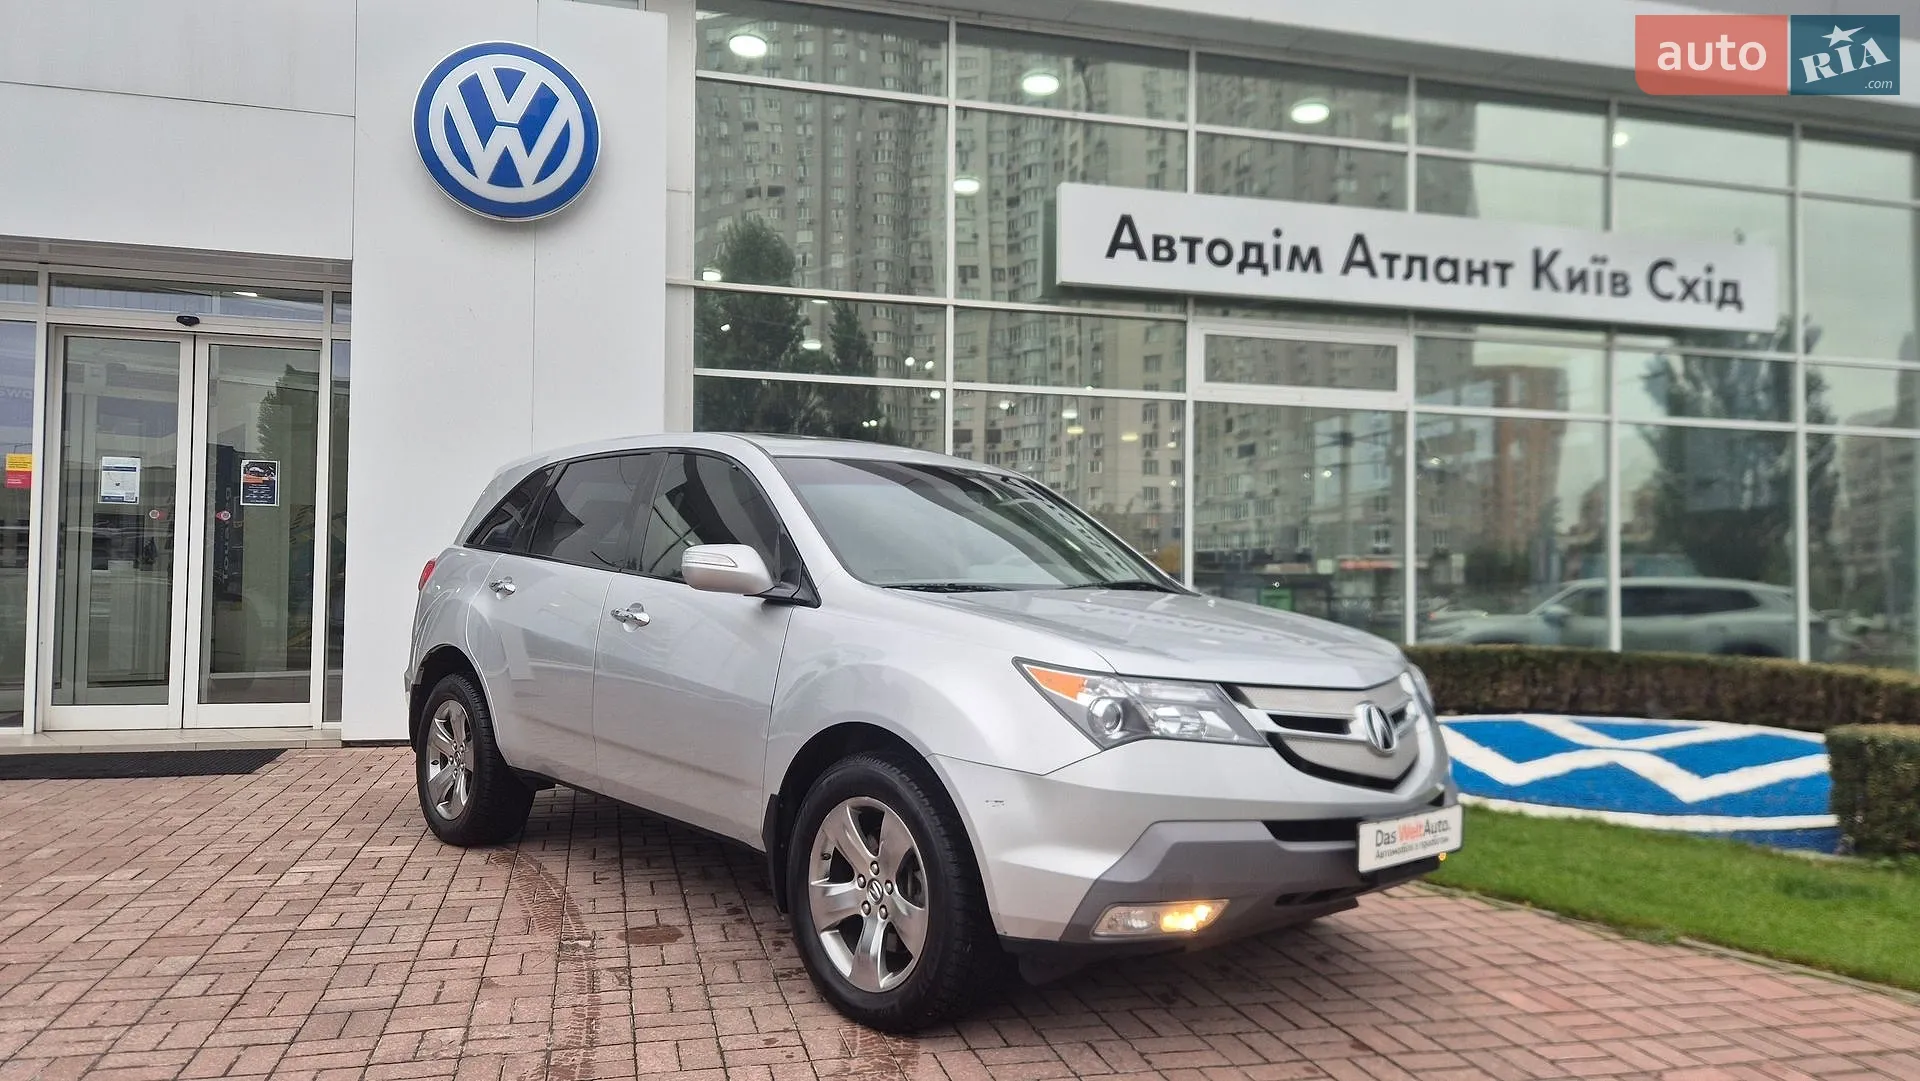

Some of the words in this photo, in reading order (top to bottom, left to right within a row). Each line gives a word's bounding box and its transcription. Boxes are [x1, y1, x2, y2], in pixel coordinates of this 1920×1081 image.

[428, 54, 585, 203] VW
[1105, 214, 1323, 276] Автодім
[1341, 233, 1514, 288] Атлант
[1533, 248, 1631, 297] Київ
[1647, 259, 1744, 311] Схід
[1375, 829, 1397, 847] Das
